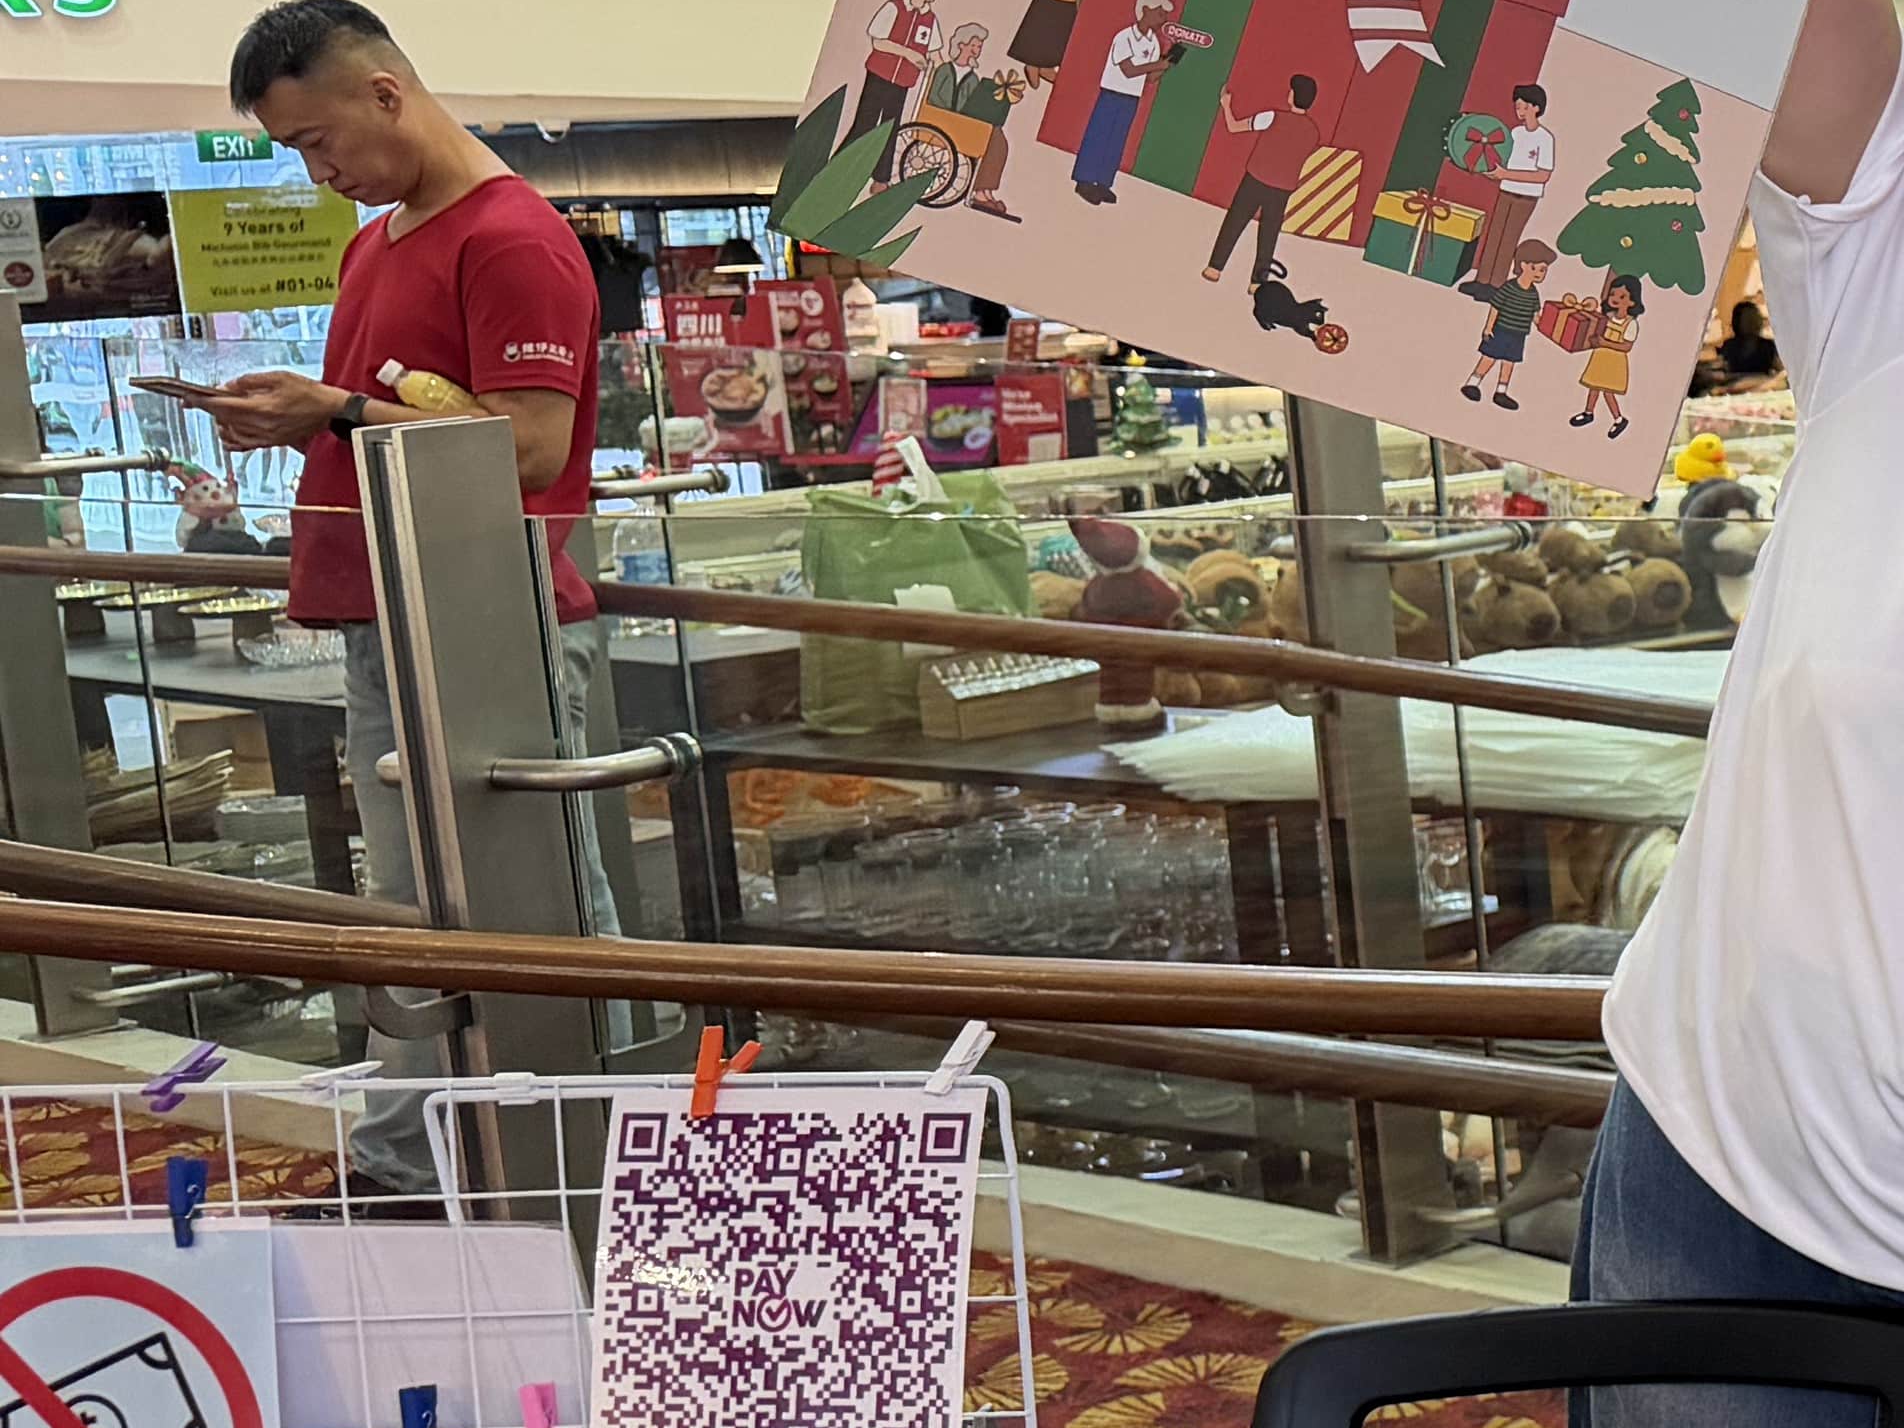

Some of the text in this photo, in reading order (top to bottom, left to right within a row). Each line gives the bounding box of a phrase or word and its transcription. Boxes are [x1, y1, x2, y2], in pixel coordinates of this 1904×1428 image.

[1168, 26, 1206, 46] DONATE
[239, 220, 284, 237] Years
[289, 219, 305, 235] of
[274, 277, 336, 295] #01-04
